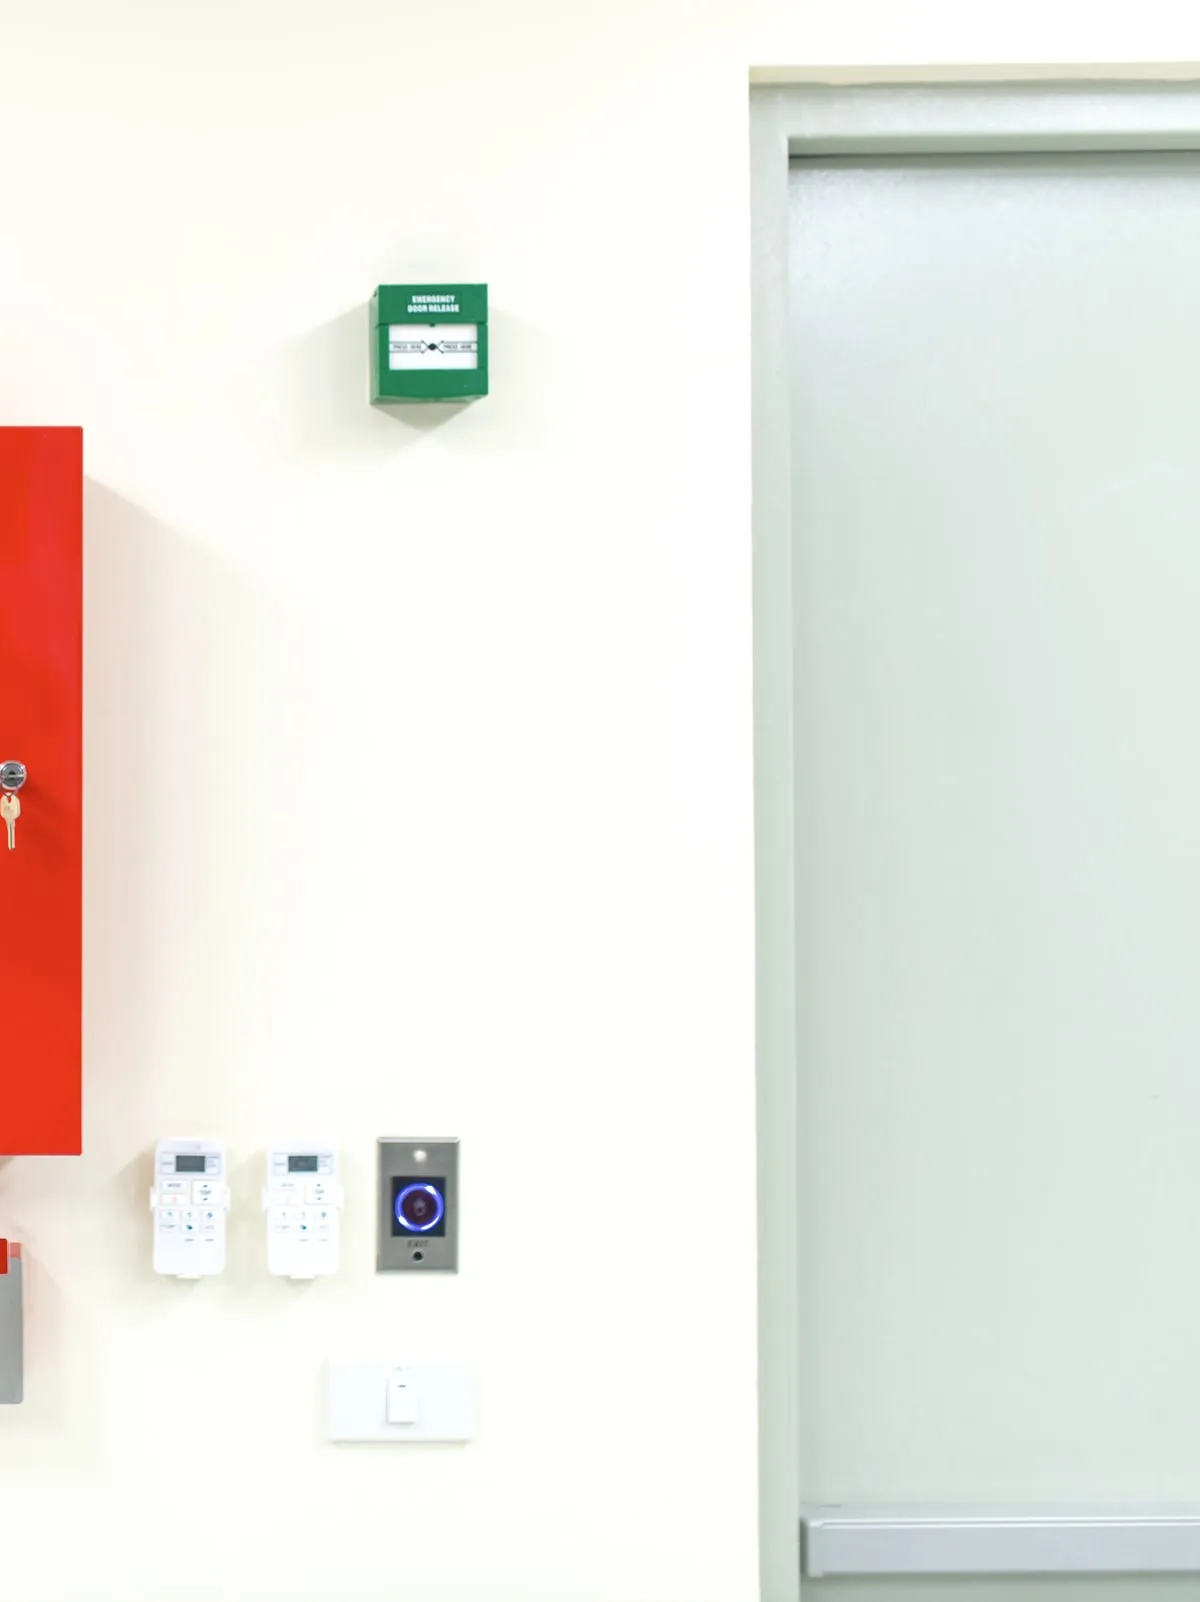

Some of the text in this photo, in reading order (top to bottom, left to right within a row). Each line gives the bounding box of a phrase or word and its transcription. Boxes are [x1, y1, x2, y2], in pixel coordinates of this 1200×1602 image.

[412, 295, 455, 303] EMERGENCY
[407, 304, 459, 313] DOOR RELEASE
